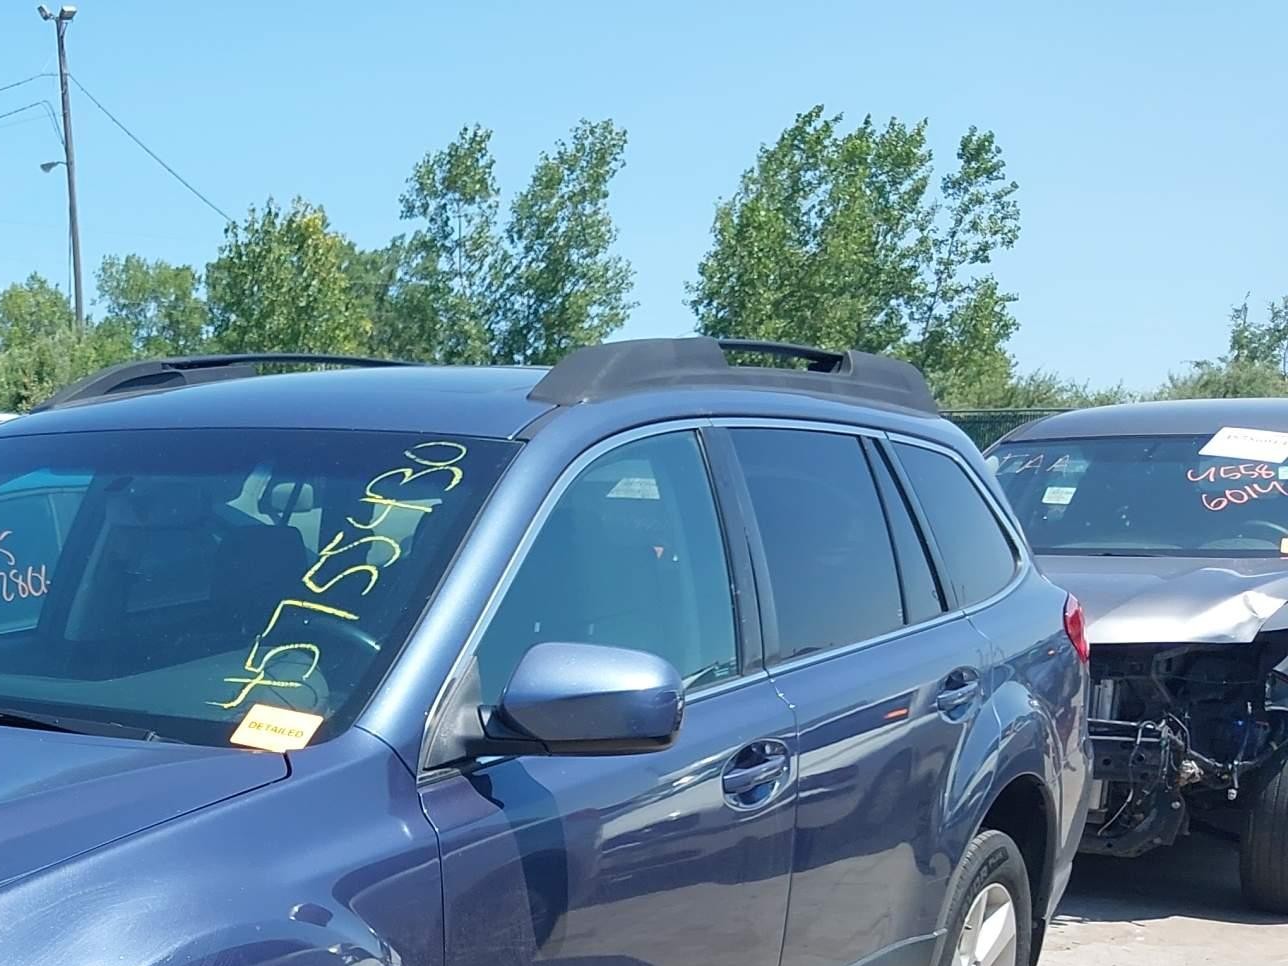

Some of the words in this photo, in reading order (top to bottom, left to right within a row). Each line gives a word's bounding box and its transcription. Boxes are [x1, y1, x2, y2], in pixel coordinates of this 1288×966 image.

[1186, 463, 1275, 482] 4558
[1201, 480, 1288, 511] 6014
[204, 441, 467, 709] 45755430
[248, 721, 305, 738] DETAILED
